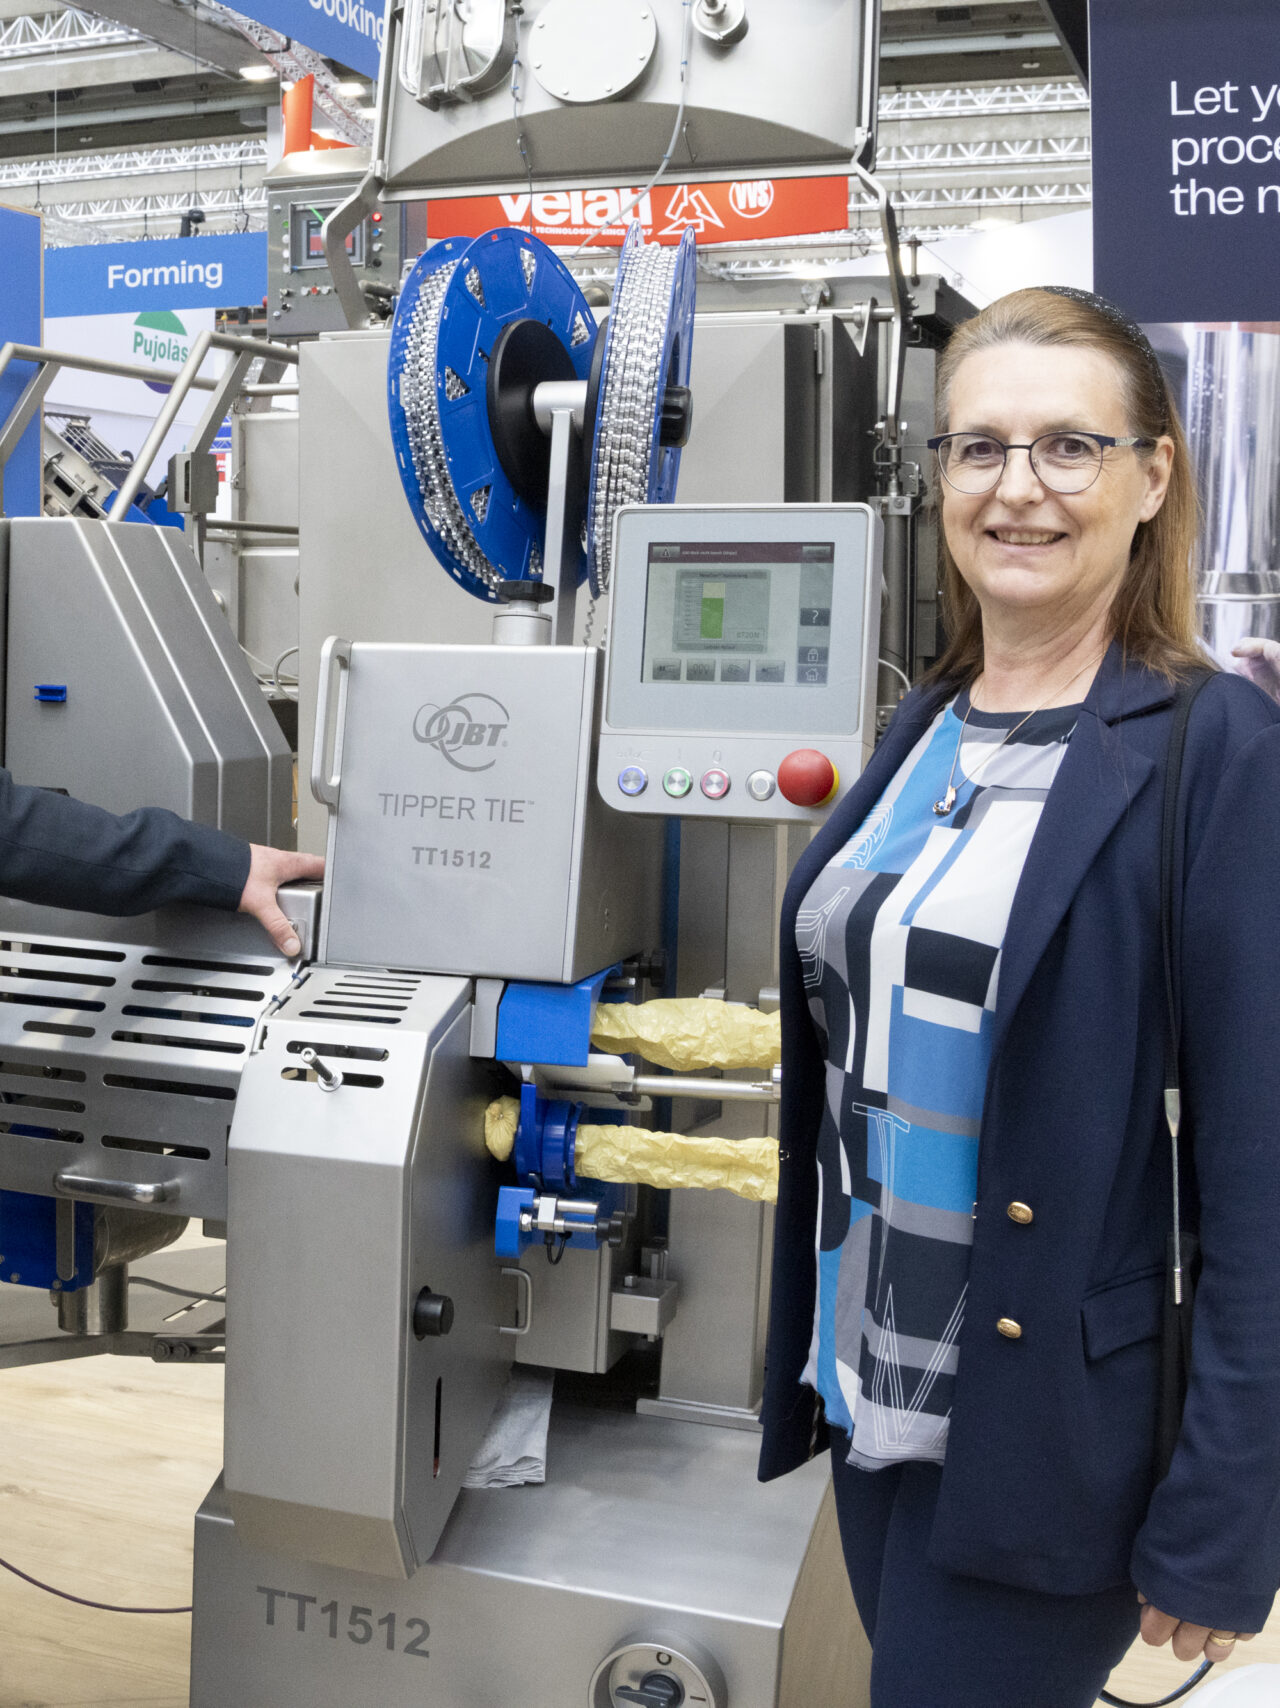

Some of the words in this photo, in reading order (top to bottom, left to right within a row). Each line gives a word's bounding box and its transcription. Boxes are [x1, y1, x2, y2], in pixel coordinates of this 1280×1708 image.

[308, 0, 384, 53] ooking
[1170, 81, 1239, 115] Let
[1250, 84, 1280, 122] y
[1172, 135, 1280, 175] proc
[734, 181, 770, 209] VVS
[1169, 178, 1244, 215] the
[107, 261, 223, 289] Forming
[133, 331, 189, 363] Pujolàs
[445, 722, 508, 747] JBT
[378, 792, 476, 821] TIPPER
[412, 846, 492, 869] TT1512
[256, 1585, 431, 1658] TT1512
